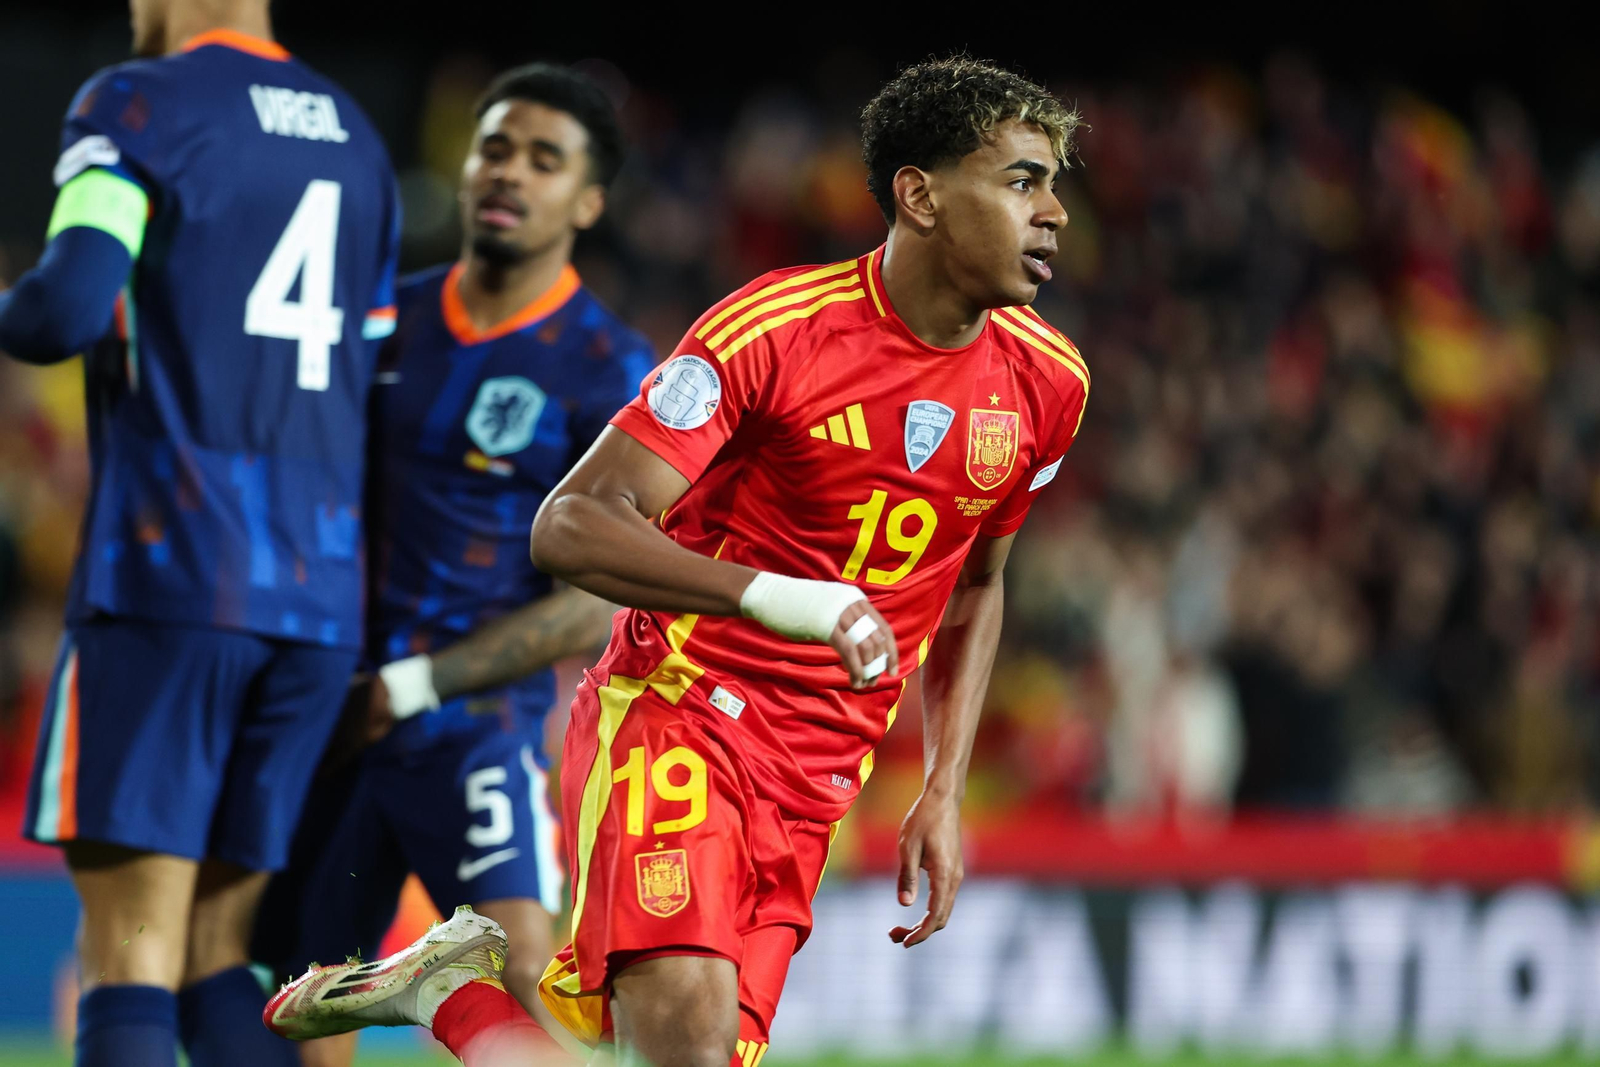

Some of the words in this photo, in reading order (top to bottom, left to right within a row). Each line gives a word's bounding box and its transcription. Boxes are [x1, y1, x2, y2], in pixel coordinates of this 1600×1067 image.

[249, 84, 348, 143] VIRGIL
[244, 179, 344, 391] 4
[682, 357, 706, 369] NATIONS
[705, 366, 719, 389] LEAGUE
[909, 416, 947, 429] CHAMPIONS
[911, 408, 949, 422] EUROPEAN
[910, 446, 929, 456] 2024
[841, 489, 938, 585] 19
[465, 766, 514, 848] 5
[612, 746, 707, 836] 19
[1124, 882, 1600, 1060] NATIO
